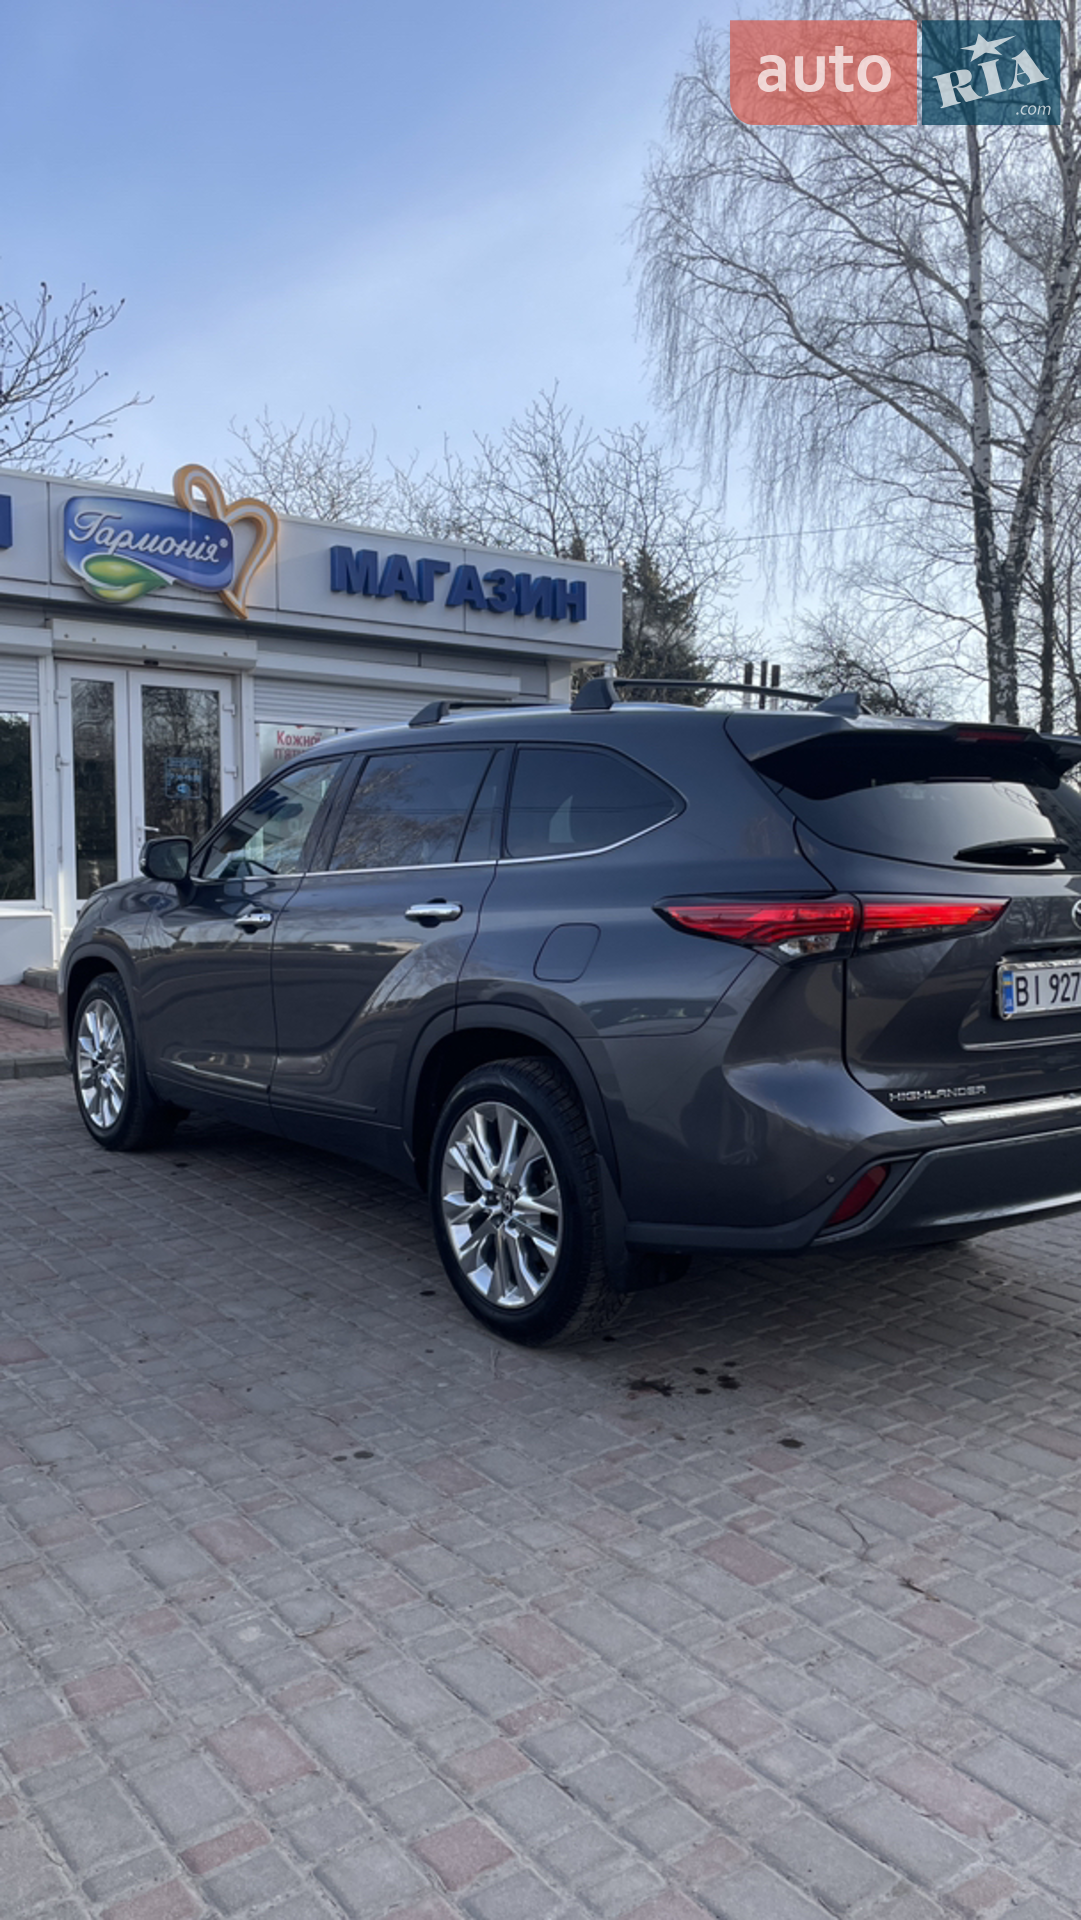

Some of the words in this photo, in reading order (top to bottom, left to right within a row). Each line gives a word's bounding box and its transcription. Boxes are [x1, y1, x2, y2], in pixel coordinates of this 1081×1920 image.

[68, 510, 220, 563] Гармонія
[330, 545, 587, 623] МАГАЗИН
[1015, 975, 1039, 1007] BI
[889, 1084, 987, 1102] HIGHLANDER
